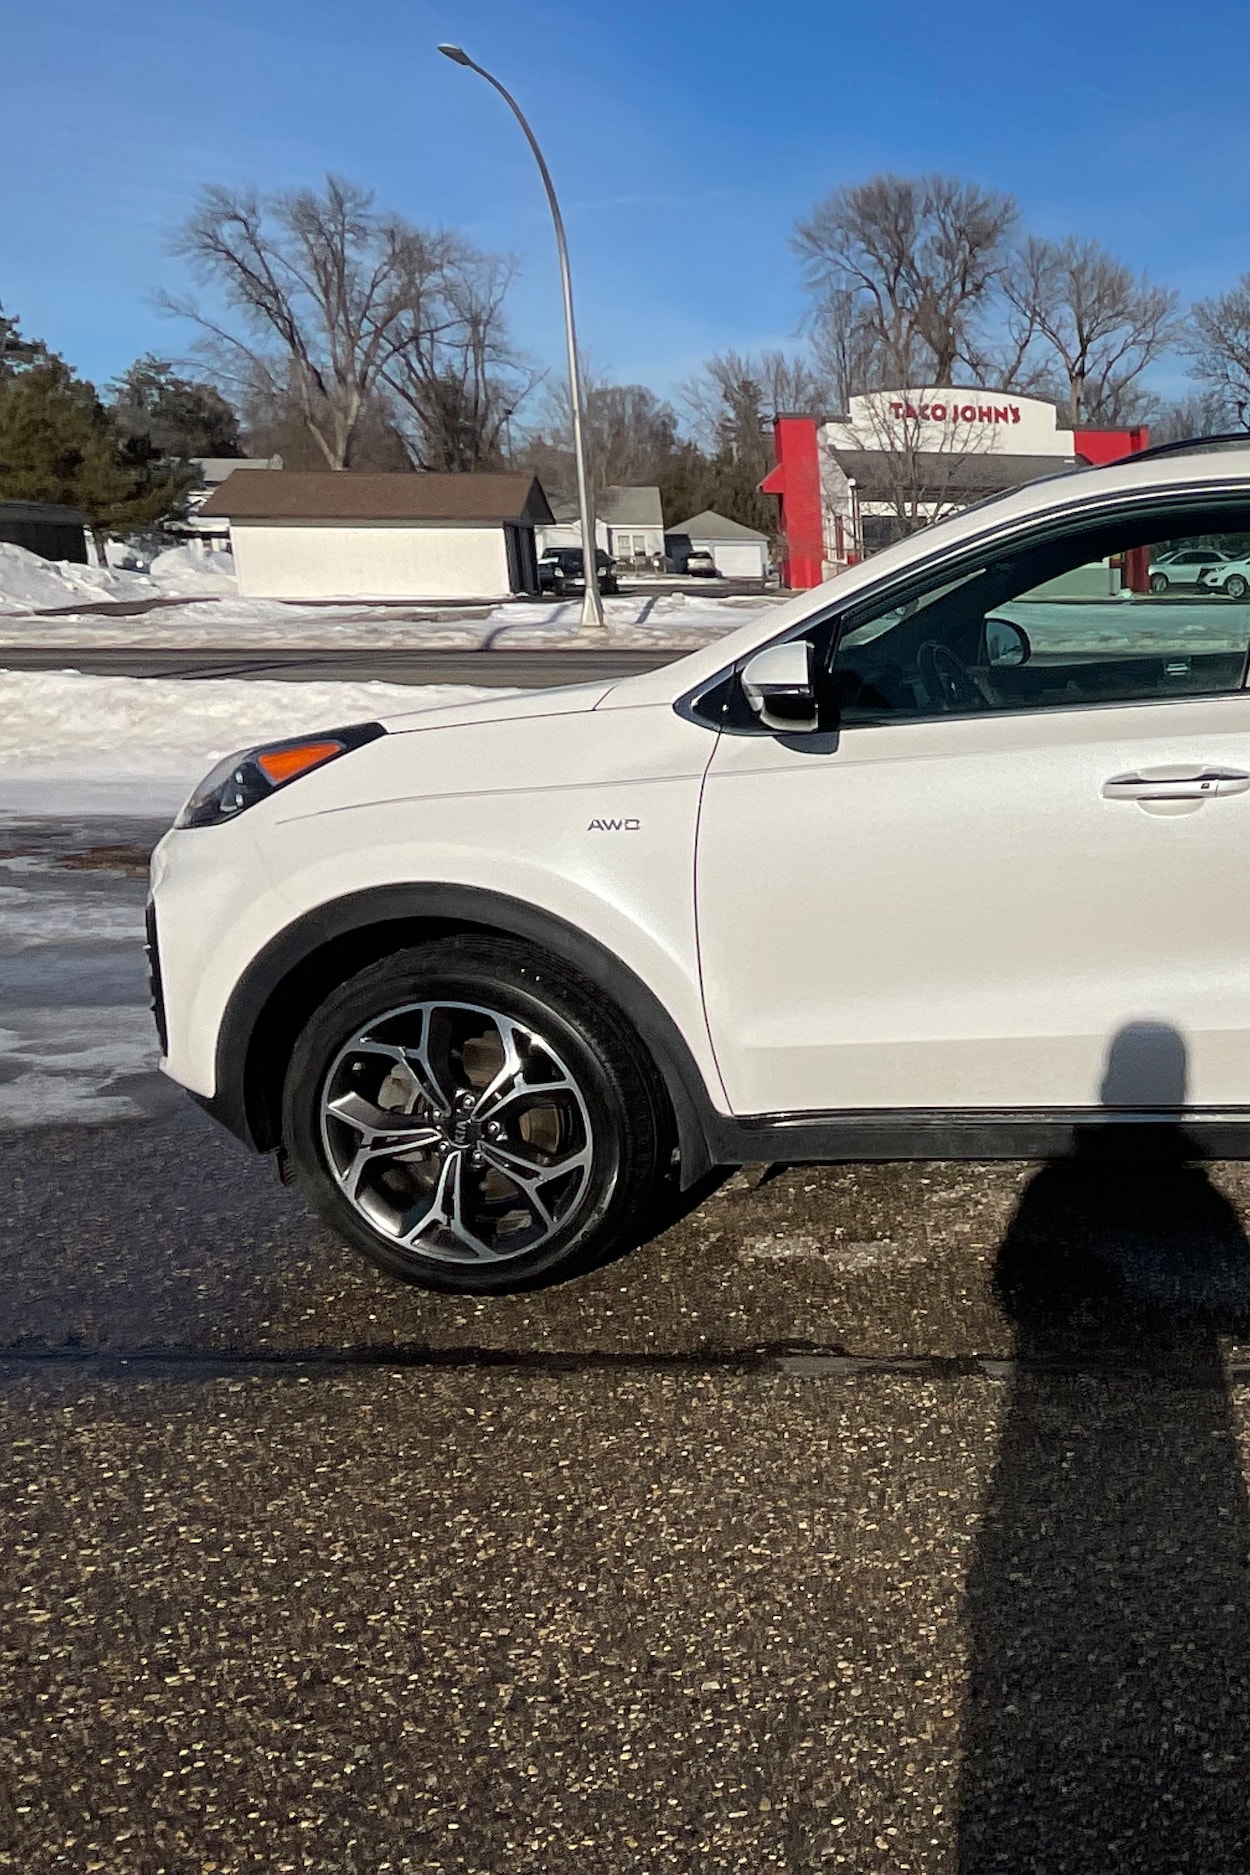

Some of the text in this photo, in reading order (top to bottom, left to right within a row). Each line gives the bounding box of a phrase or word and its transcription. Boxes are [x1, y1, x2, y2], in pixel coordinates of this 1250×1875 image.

[889, 402, 1021, 424] TACO JOHN'S
[587, 818, 640, 831] AWD
